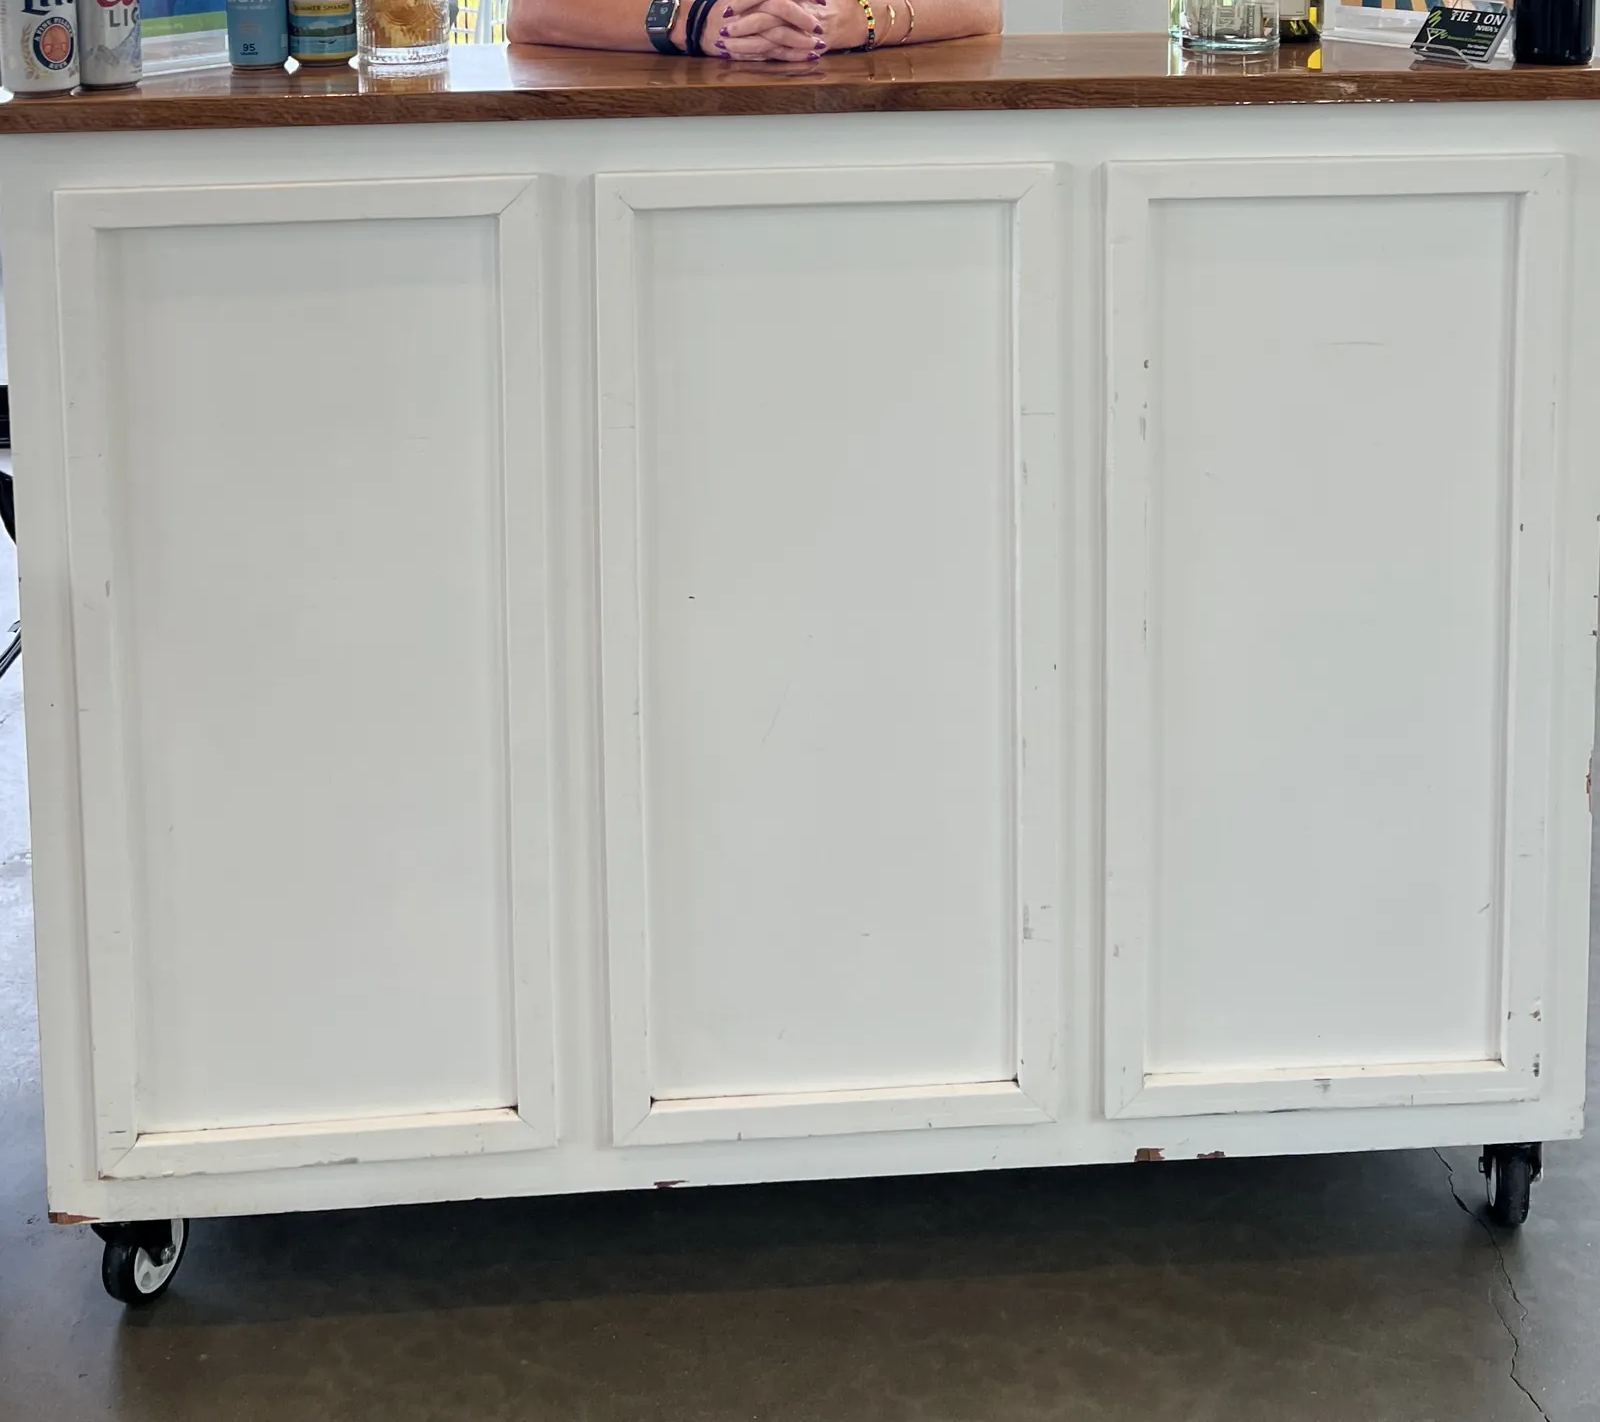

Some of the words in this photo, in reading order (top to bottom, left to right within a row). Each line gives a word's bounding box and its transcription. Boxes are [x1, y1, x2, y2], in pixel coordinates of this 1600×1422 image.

[1450, 9, 1472, 23] TIE
[1473, 13, 1481, 24] 1
[1483, 13, 1505, 27] ON
[242, 43, 256, 52] 95
